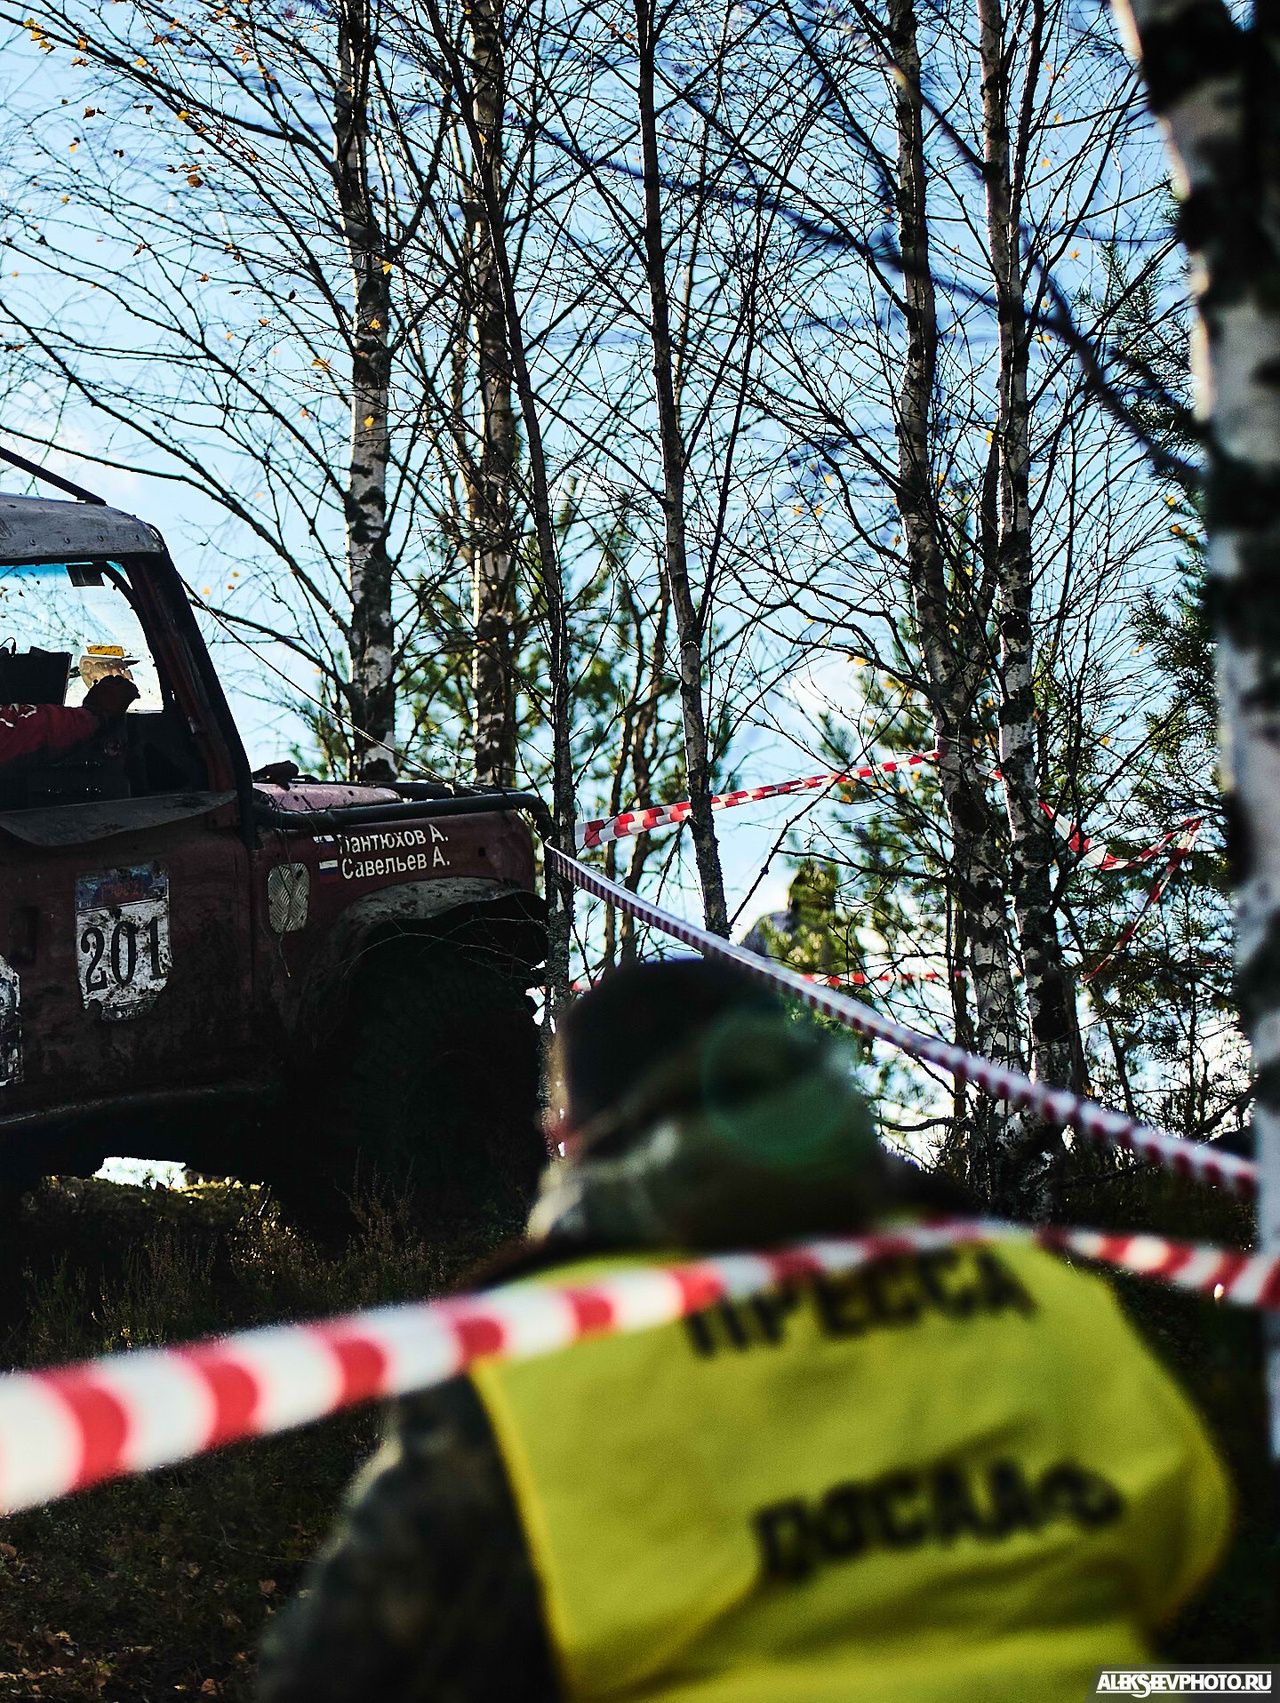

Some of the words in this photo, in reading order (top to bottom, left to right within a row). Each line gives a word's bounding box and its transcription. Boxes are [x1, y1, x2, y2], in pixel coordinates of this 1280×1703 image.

[341, 853, 428, 880] Савельев
[80, 916, 167, 994] 201
[684, 1246, 1038, 1360] ПРЕССА
